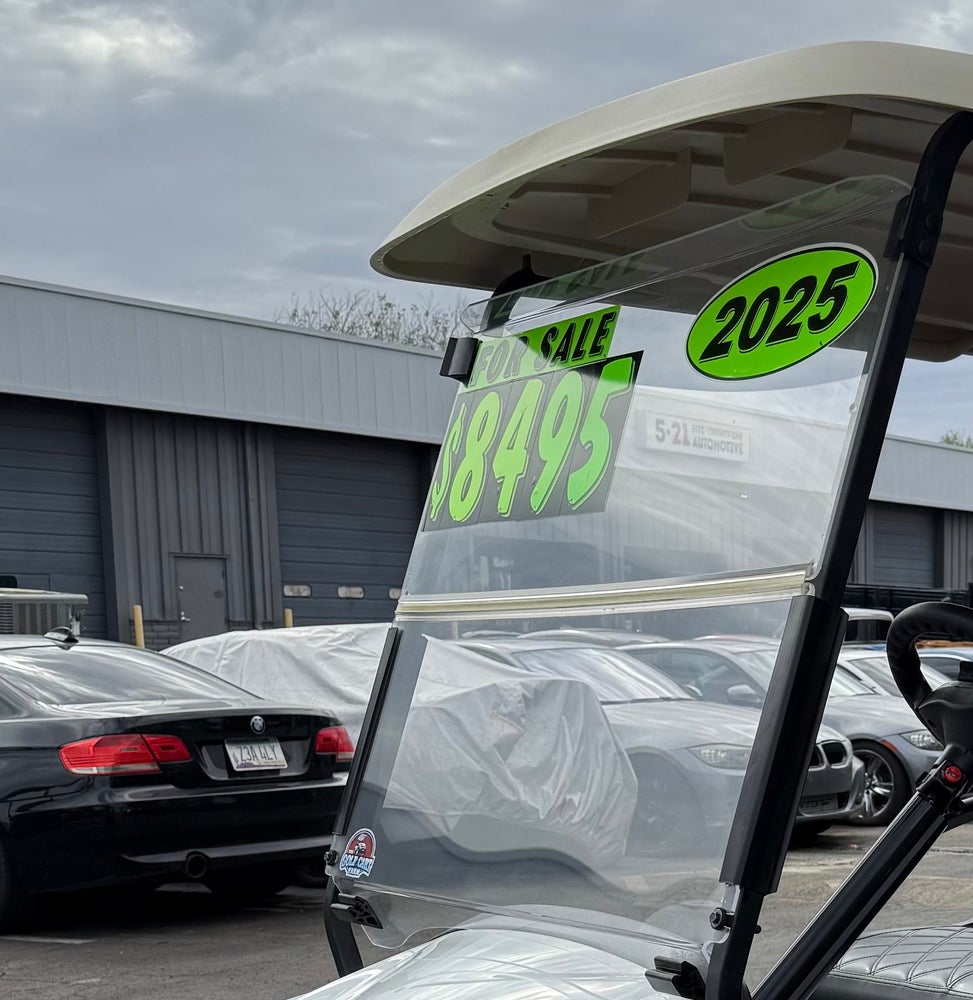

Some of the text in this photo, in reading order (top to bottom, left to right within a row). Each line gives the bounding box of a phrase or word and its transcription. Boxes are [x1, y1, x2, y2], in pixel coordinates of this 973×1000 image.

[470, 311, 616, 387] FOR SALE
[699, 260, 860, 363] 2025
[430, 357, 636, 523] $8495
[692, 436, 745, 456] AUTOMOTIVE
